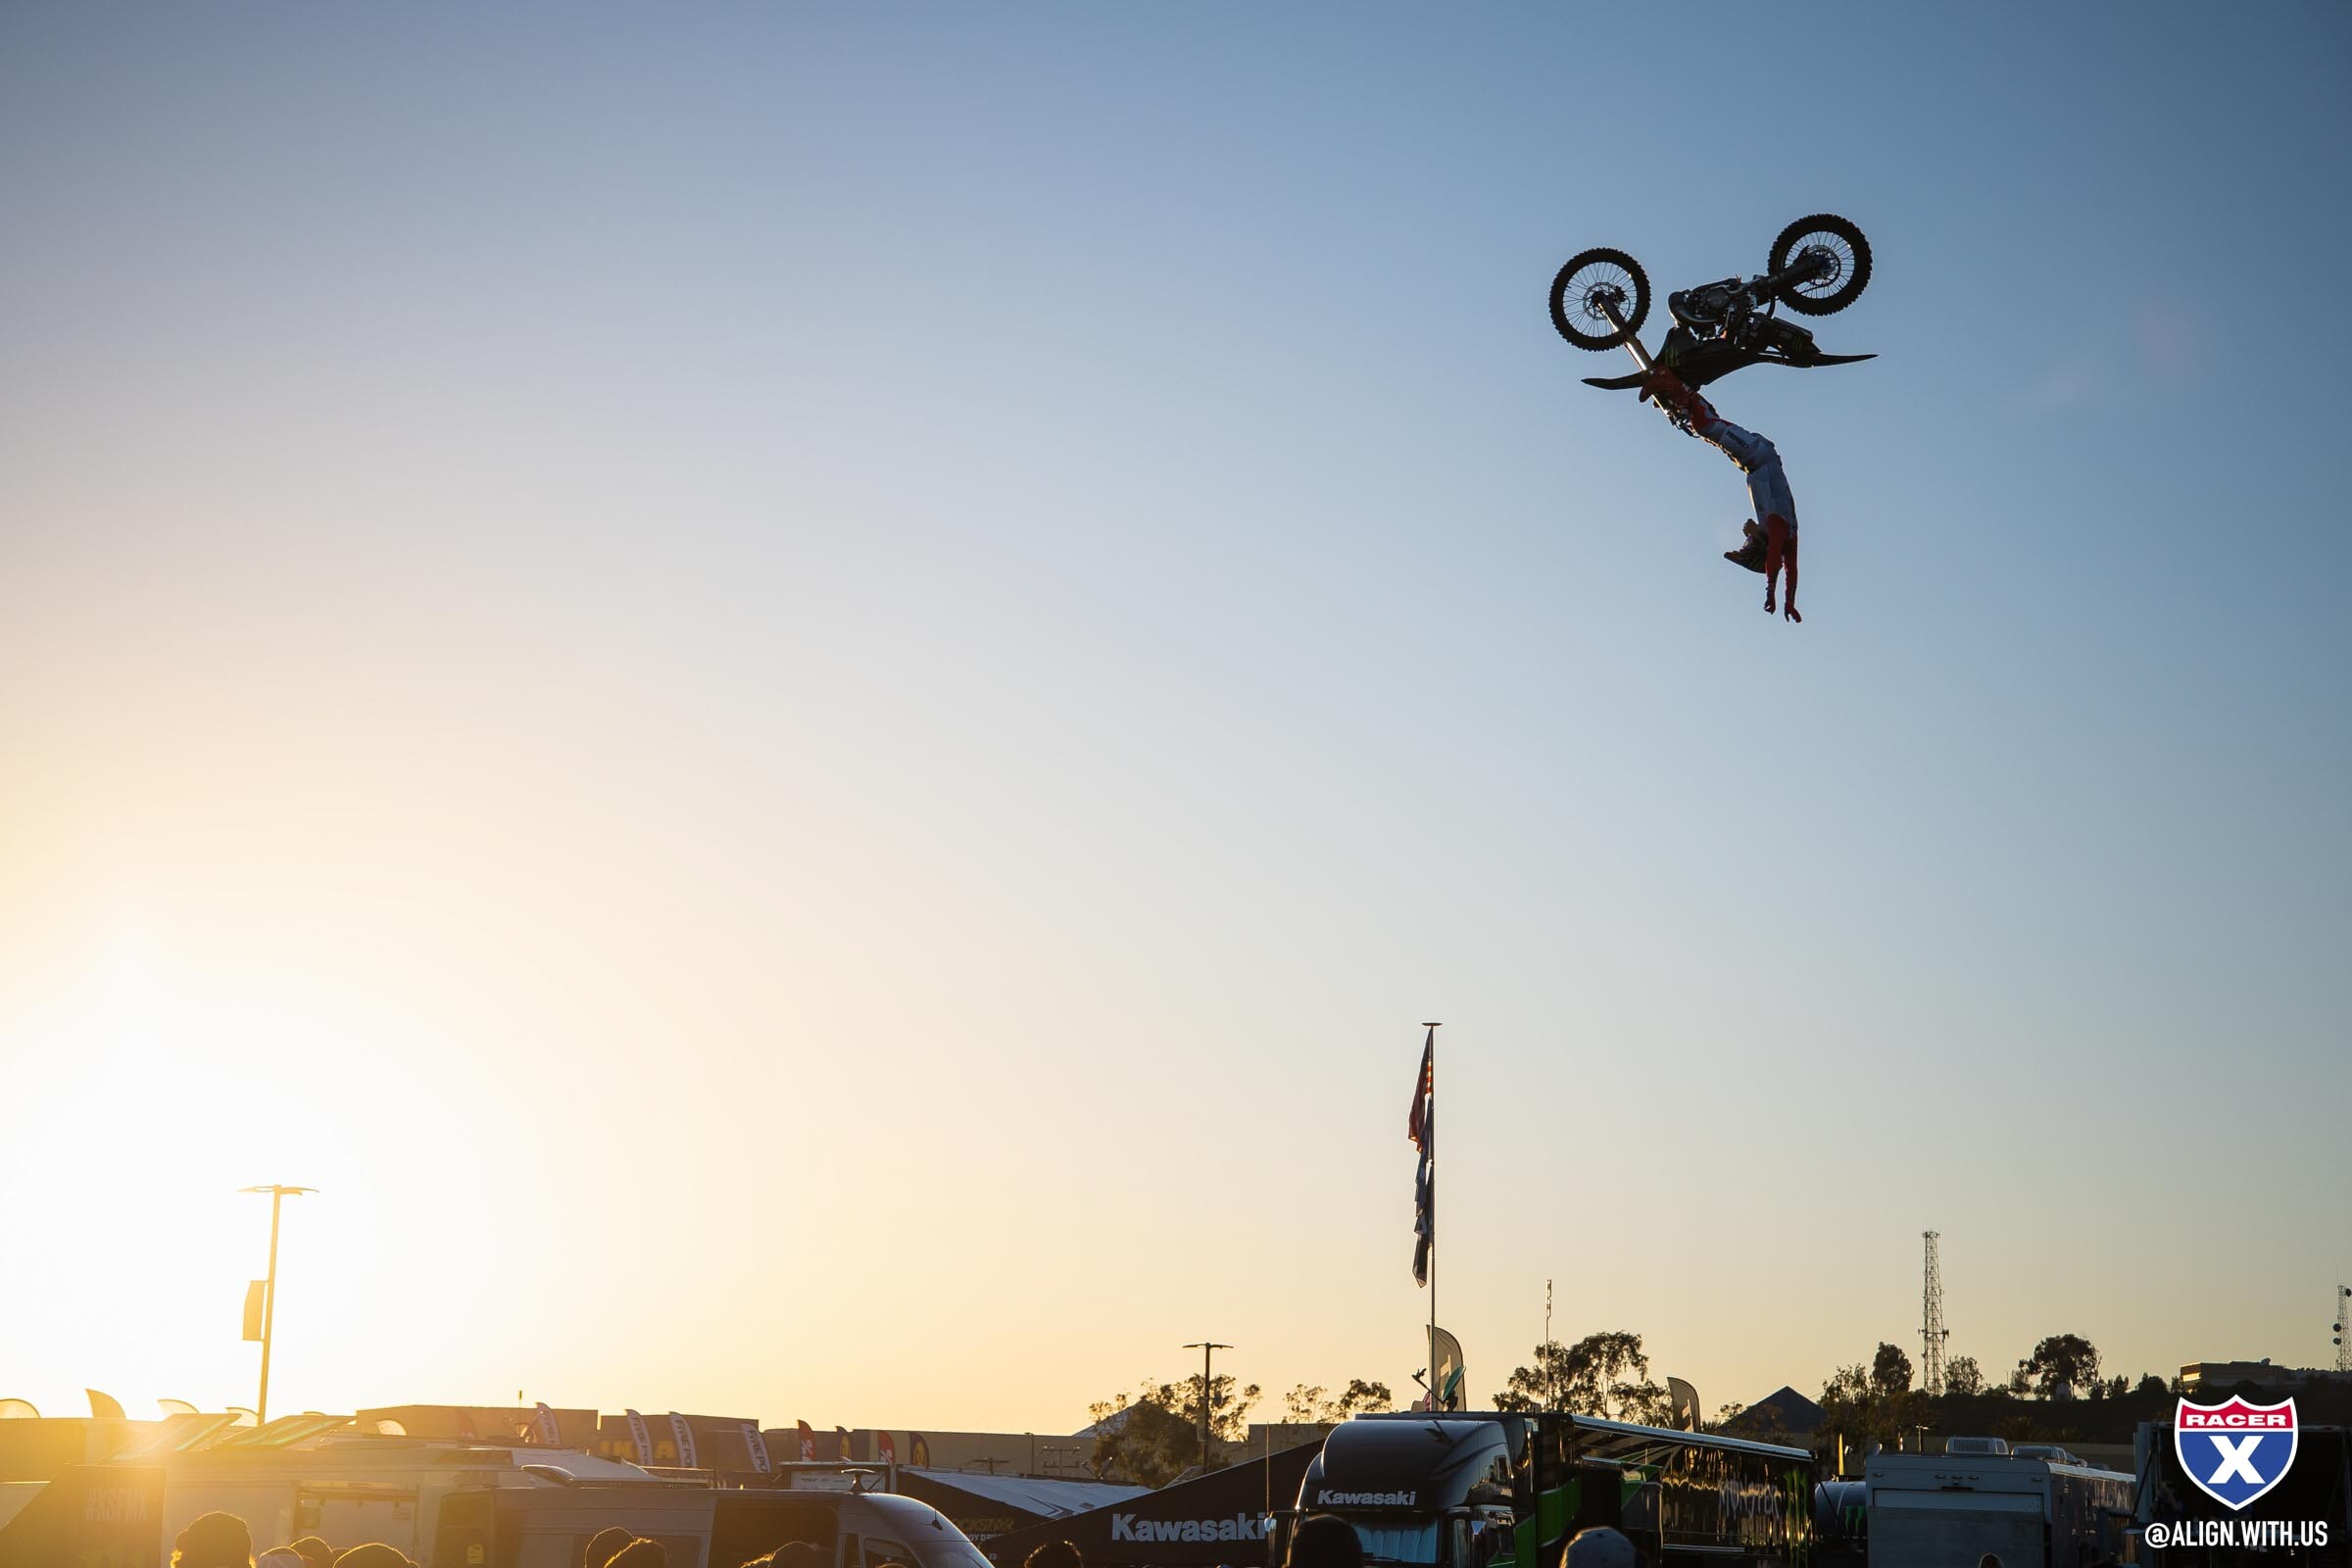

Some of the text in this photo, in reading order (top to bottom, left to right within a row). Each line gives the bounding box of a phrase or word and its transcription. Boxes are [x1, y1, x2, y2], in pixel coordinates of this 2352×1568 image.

[599, 1441, 675, 1459] IKA
[1317, 1490, 1416, 1506] Kawasaki
[1111, 1512, 1269, 1543] Kawasaki
